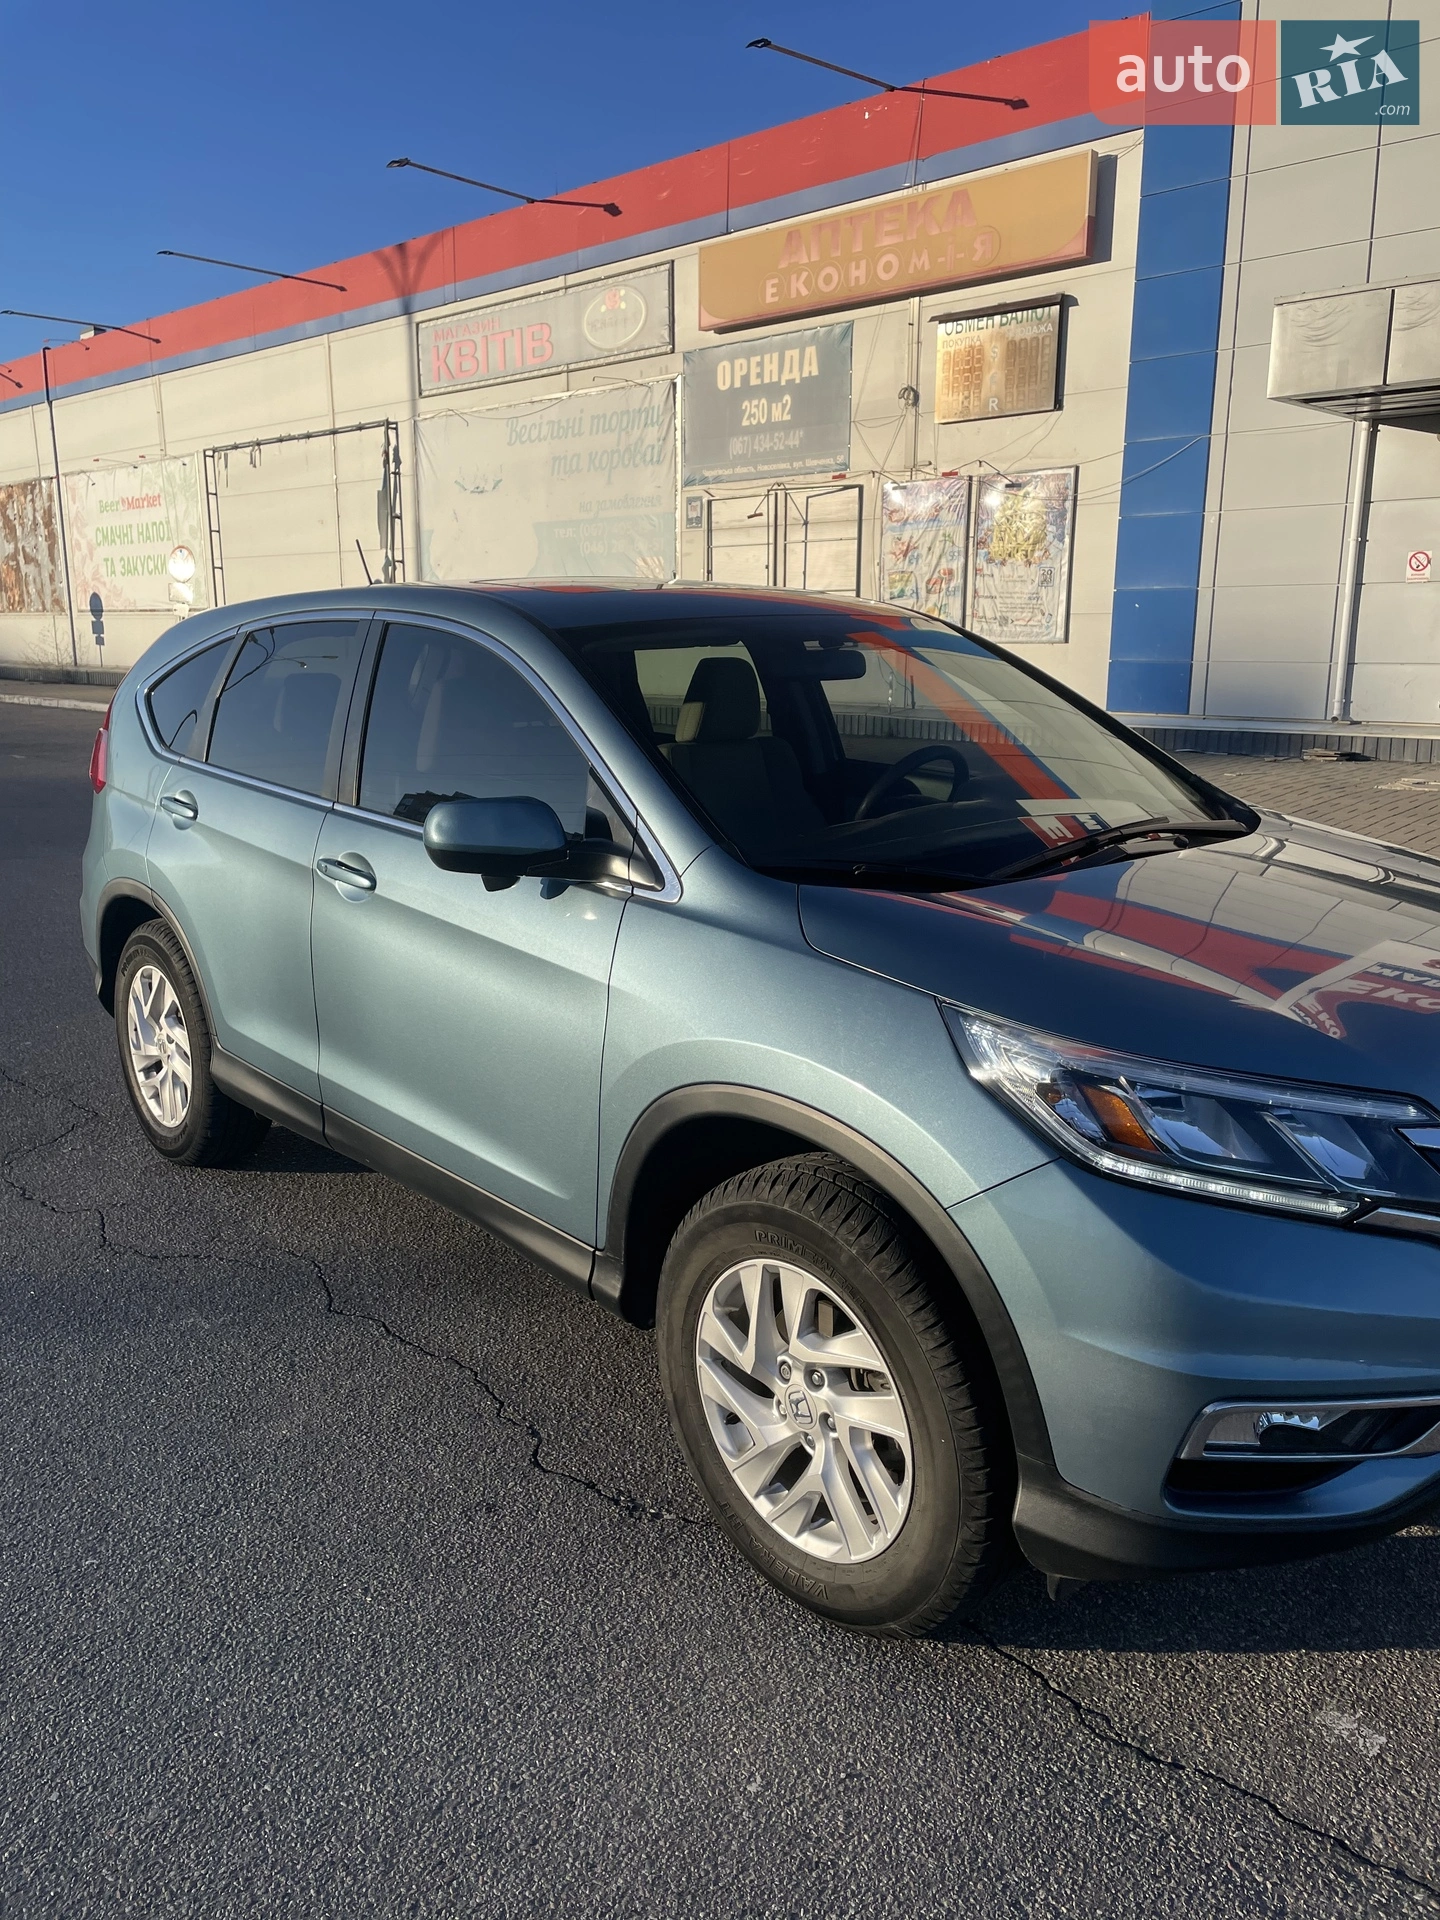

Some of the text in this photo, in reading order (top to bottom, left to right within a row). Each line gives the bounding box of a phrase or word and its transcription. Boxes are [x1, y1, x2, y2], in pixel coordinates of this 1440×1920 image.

[778, 188, 977, 269] АПТЕКА
[433, 317, 501, 342] МАГАЗИН
[942, 335, 982, 349] ПОКУПКА
[431, 322, 554, 383] КВІТІВ
[717, 345, 819, 391] ОРЕНДА
[741, 394, 792, 426] 250 м2
[506, 403, 665, 447] Весільні торти
[729, 436, 752, 460] (067)
[551, 452, 583, 476] та
[99, 493, 162, 513] Beer Market
[95, 517, 172, 547] СМАЧНІ НАПОЇ
[104, 554, 167, 577] ТА ЗАКУСКИ
[719, 1502, 744, 1531] HT
[749, 1534, 829, 1600] VALERA
